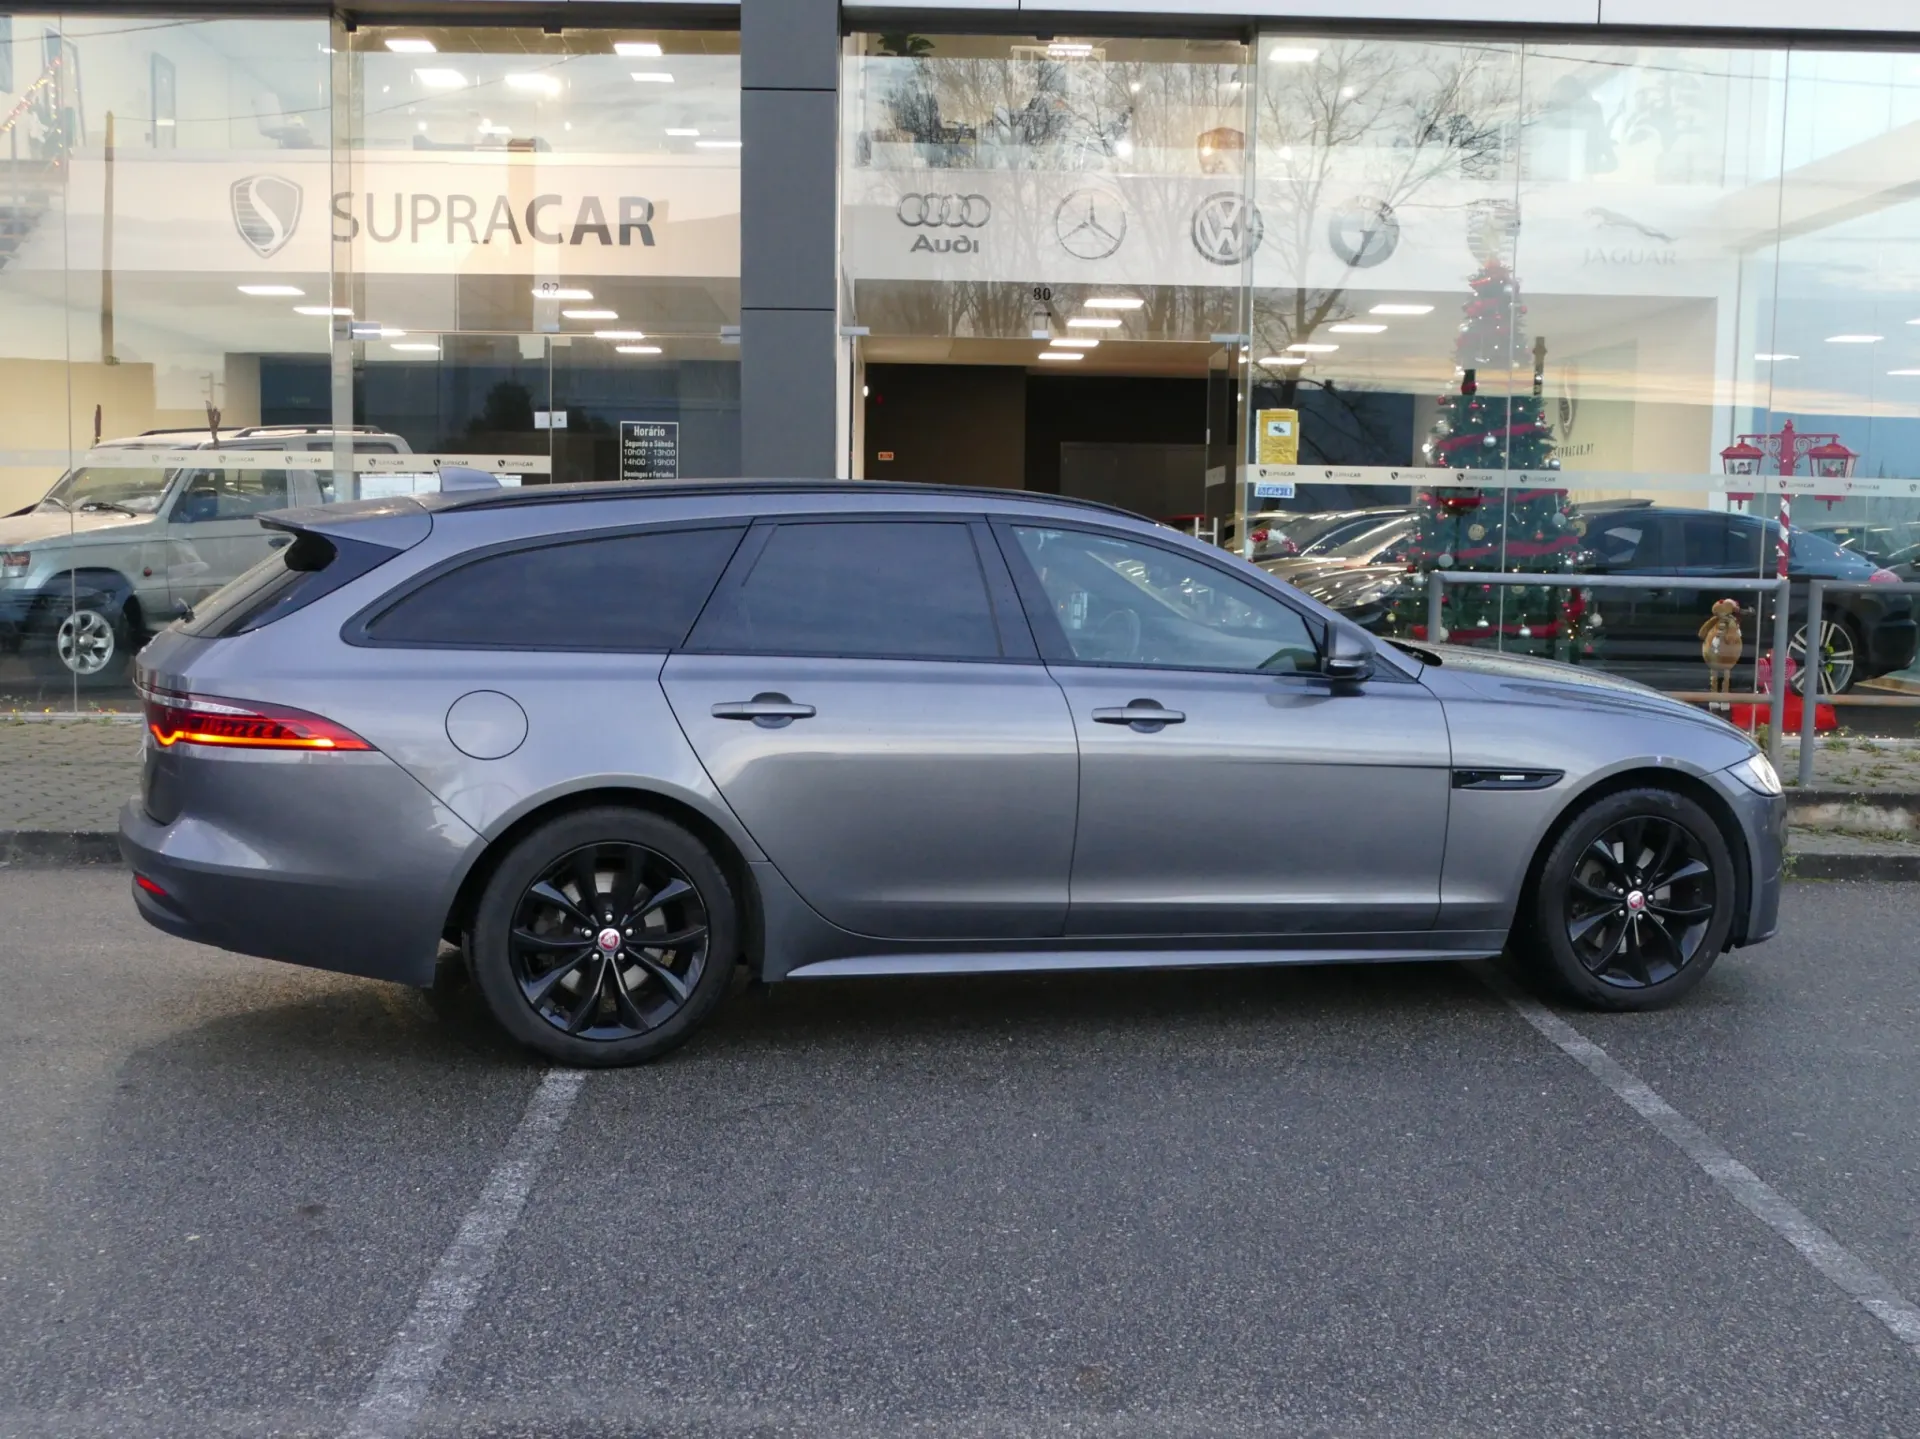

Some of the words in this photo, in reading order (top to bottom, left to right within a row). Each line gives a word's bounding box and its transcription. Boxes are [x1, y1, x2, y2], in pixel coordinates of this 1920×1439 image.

[328, 191, 656, 247] SUPRACAR
[910, 234, 979, 253] Audi
[1582, 246, 1678, 267] JAGUAR
[1033, 287, 1051, 300] 80
[633, 425, 666, 437] Horário
